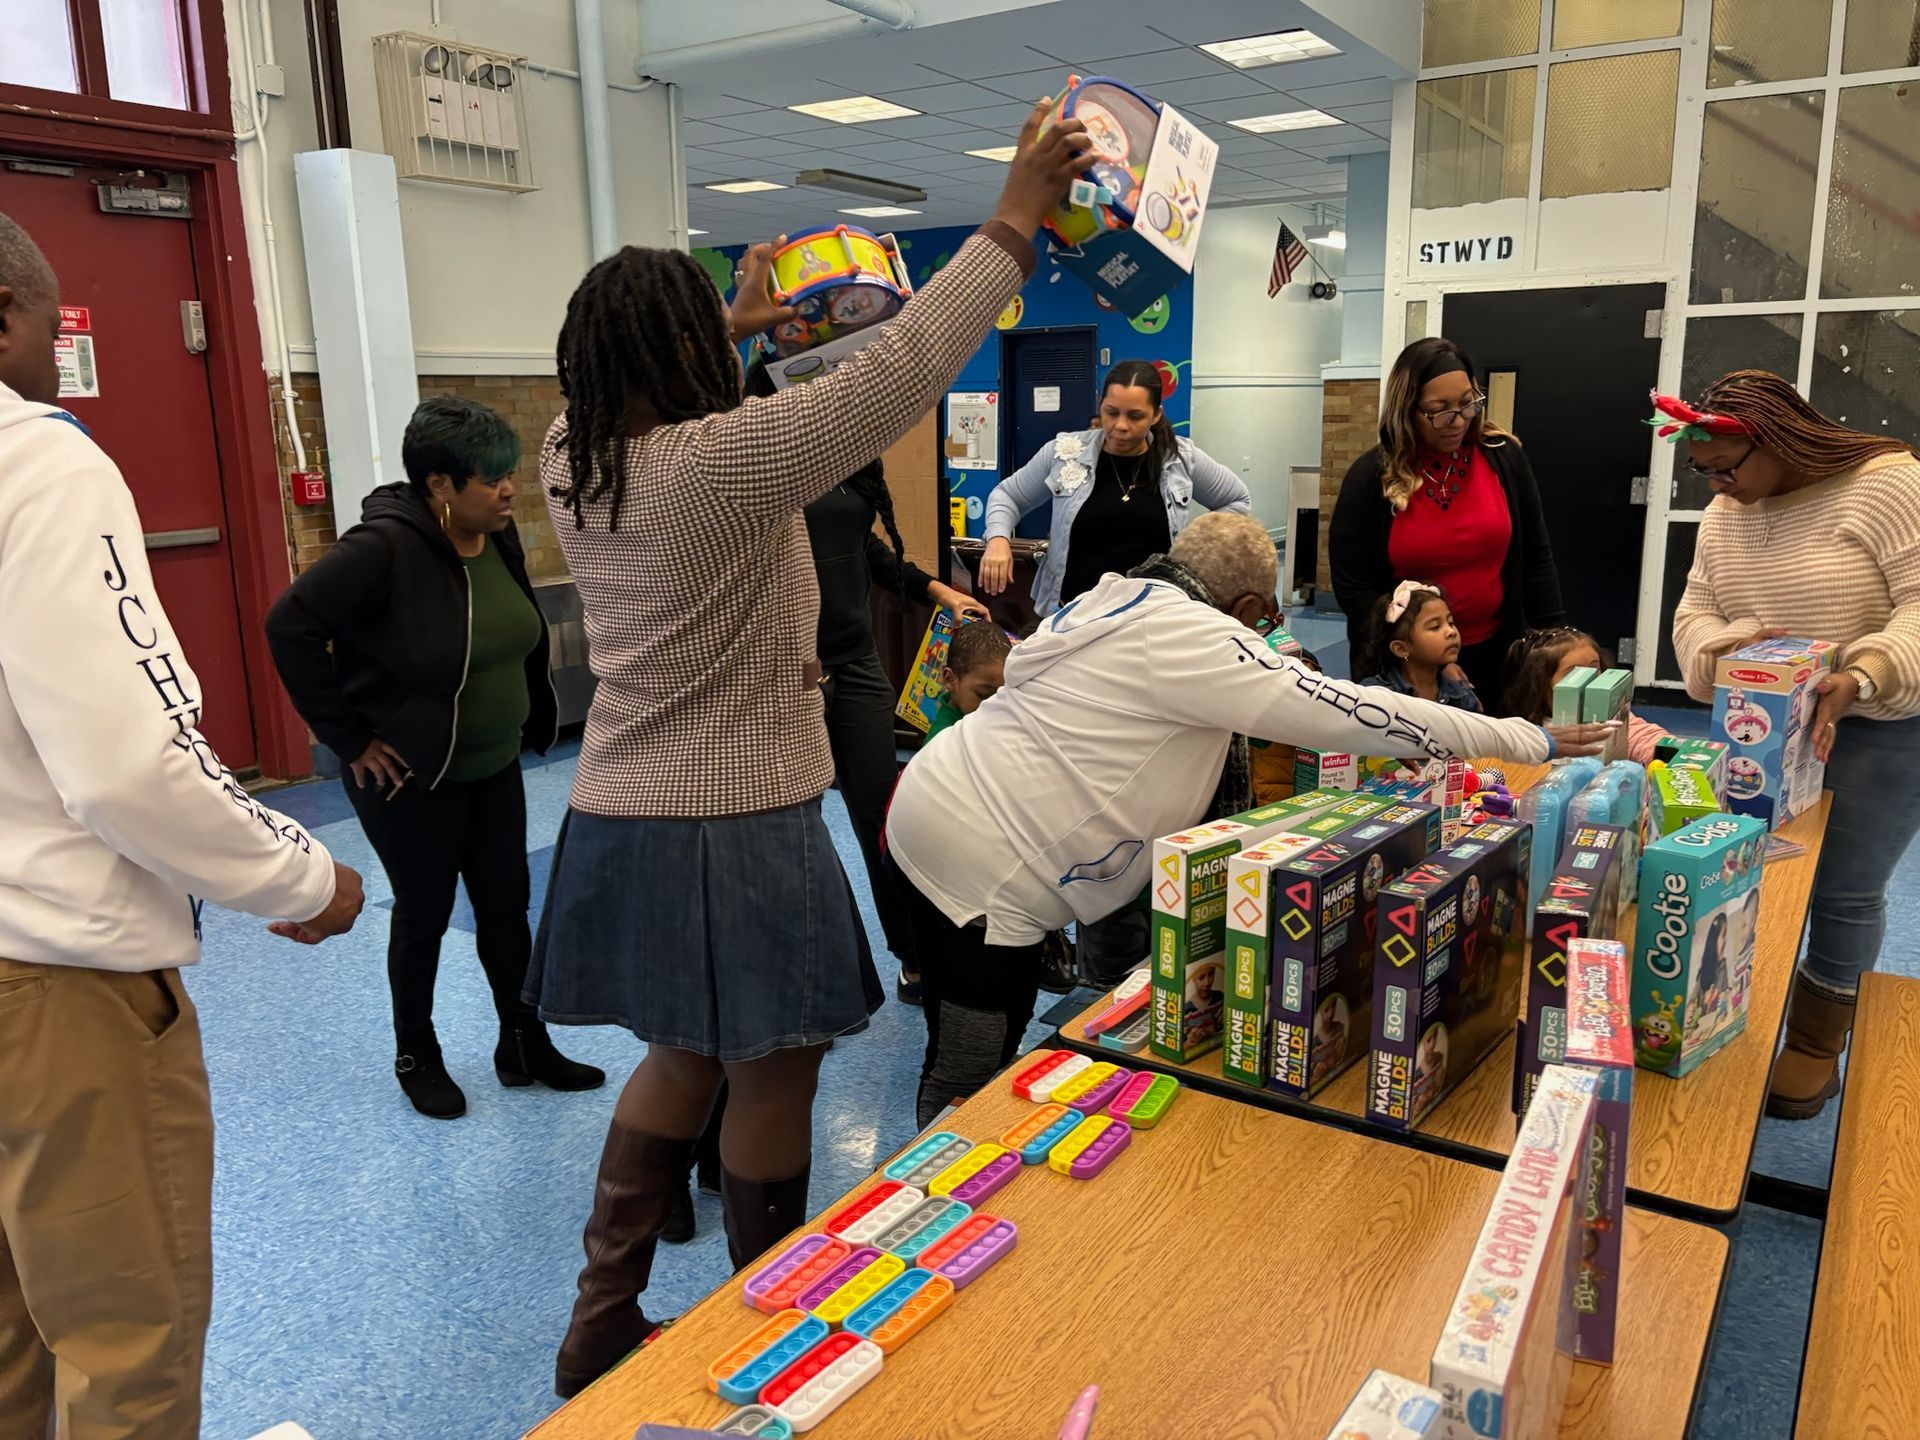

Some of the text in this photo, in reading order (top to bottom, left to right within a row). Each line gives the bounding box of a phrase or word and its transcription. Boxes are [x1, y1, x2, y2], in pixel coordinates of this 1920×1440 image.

[1419, 236, 1514, 264] STWYD
[1323, 756, 1349, 767] winfun
[1673, 820, 1740, 848] Cootie
[1191, 856, 1228, 881] MAGN
[1191, 872, 1228, 898] BUILD
[1322, 877, 1357, 909] MAGNE
[1700, 871, 1721, 890] Cootie
[1427, 900, 1457, 937] MAGNE
[1646, 873, 1690, 980] Cootie
[1155, 987, 1167, 1046] MAGNE
[1165, 991, 1178, 1050] BUILDS
[1230, 1008, 1244, 1069] MAGNE
[1242, 1012, 1257, 1073] BUILDS
[1275, 1020, 1291, 1082] MAGNE
[1288, 1025, 1304, 1087] BUILDS
[1375, 1050, 1393, 1115] MAGNE
[1389, 1055, 1408, 1120] BUILDS
[1480, 1146, 1560, 1279] CANDY LAND
